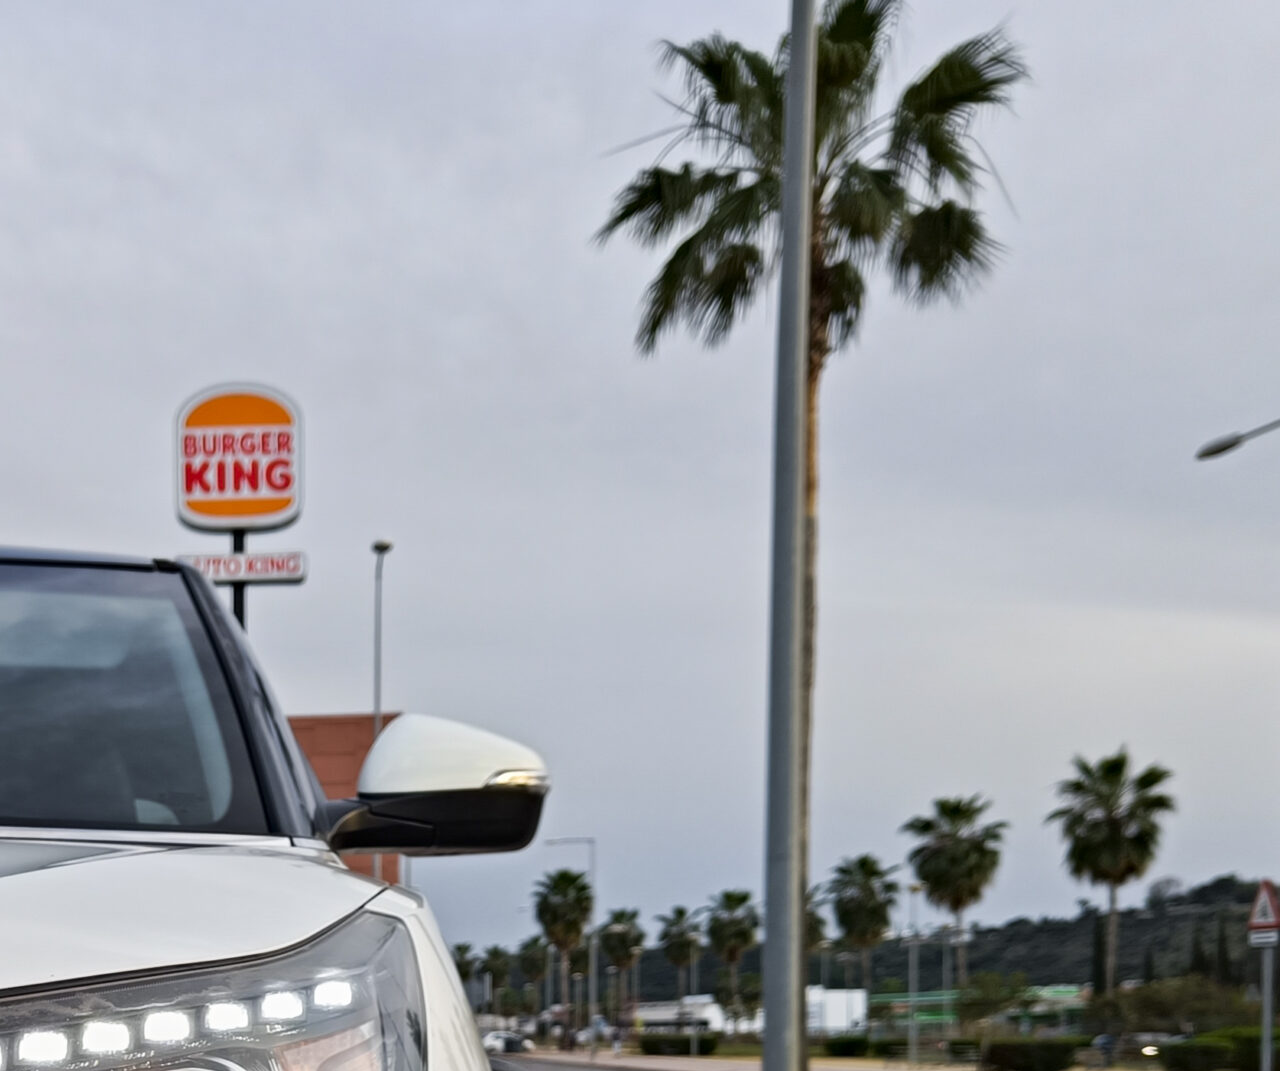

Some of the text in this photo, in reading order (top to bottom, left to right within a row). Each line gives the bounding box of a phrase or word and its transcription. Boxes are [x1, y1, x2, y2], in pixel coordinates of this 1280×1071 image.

[184, 431, 292, 457] BURGER
[184, 459, 292, 494] KING
[245, 554, 300, 574] KING
